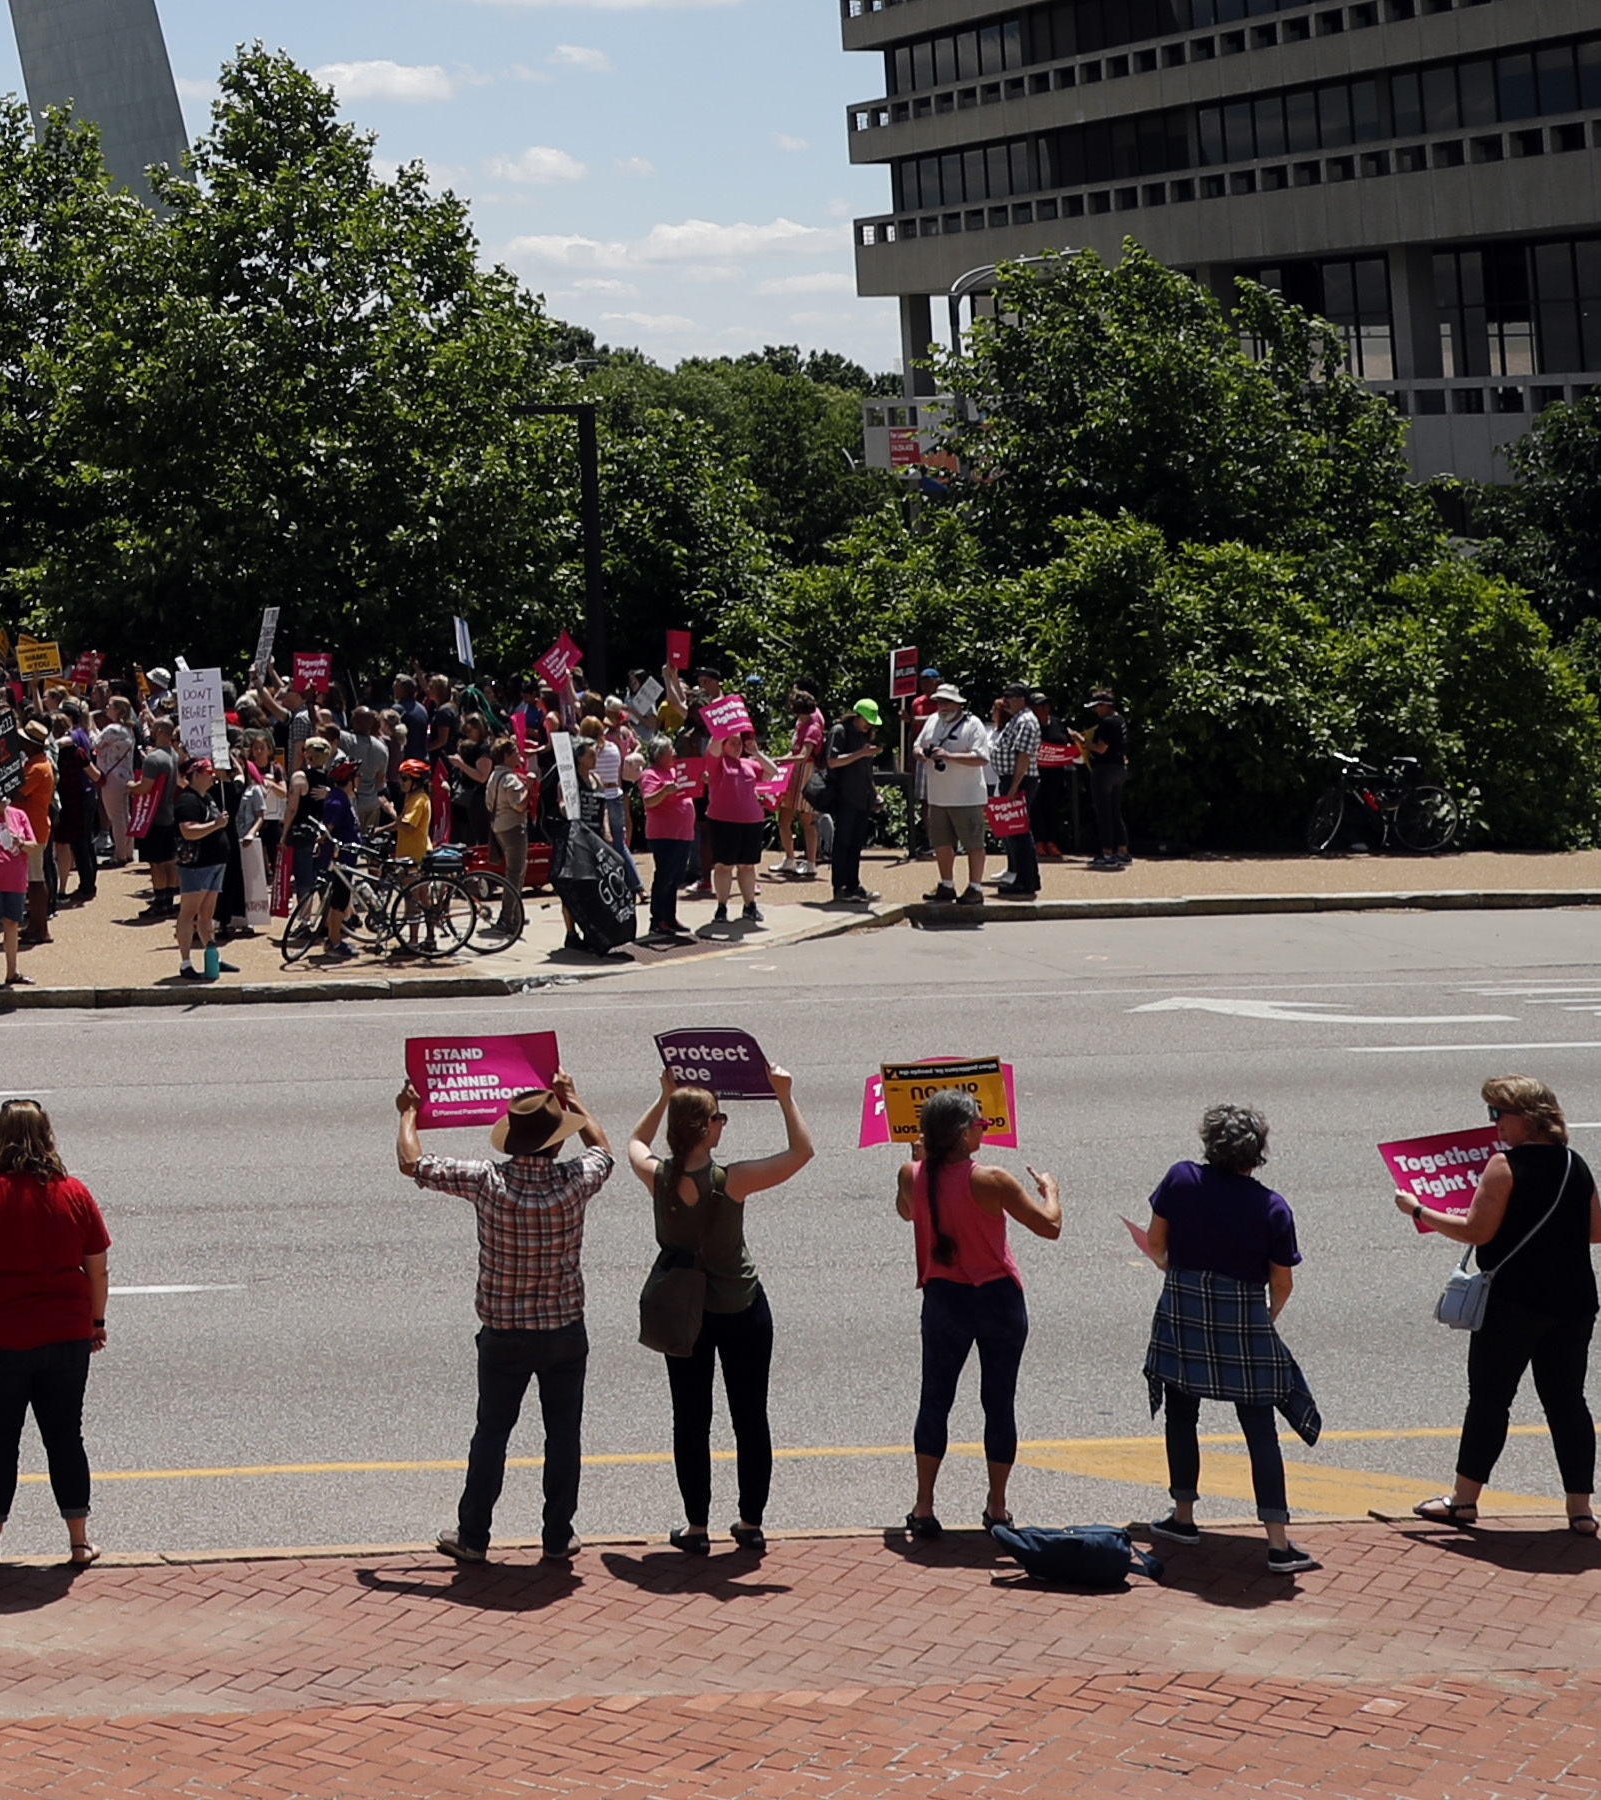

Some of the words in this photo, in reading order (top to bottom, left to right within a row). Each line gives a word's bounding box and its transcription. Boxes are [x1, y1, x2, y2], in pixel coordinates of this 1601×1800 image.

[193, 671, 204, 683] I
[181, 704, 215, 718] REGRET
[190, 724, 208, 736] MY
[183, 736, 212, 749] ABORT
[994, 810, 1019, 822] Fight
[424, 1048, 430, 1061] I
[434, 1048, 484, 1061] STAND
[662, 1045, 750, 1064] Protect
[426, 1062, 467, 1076] WITH
[670, 1064, 711, 1082] Roe
[427, 1074, 499, 1090] PLANNED
[438, 1108, 463, 1117] Planned
[464, 1106, 498, 1116] Parenthood
[893, 1122, 920, 1136] rson
[1392, 1146, 1490, 1174] Together
[1409, 1173, 1468, 1199] Fight
